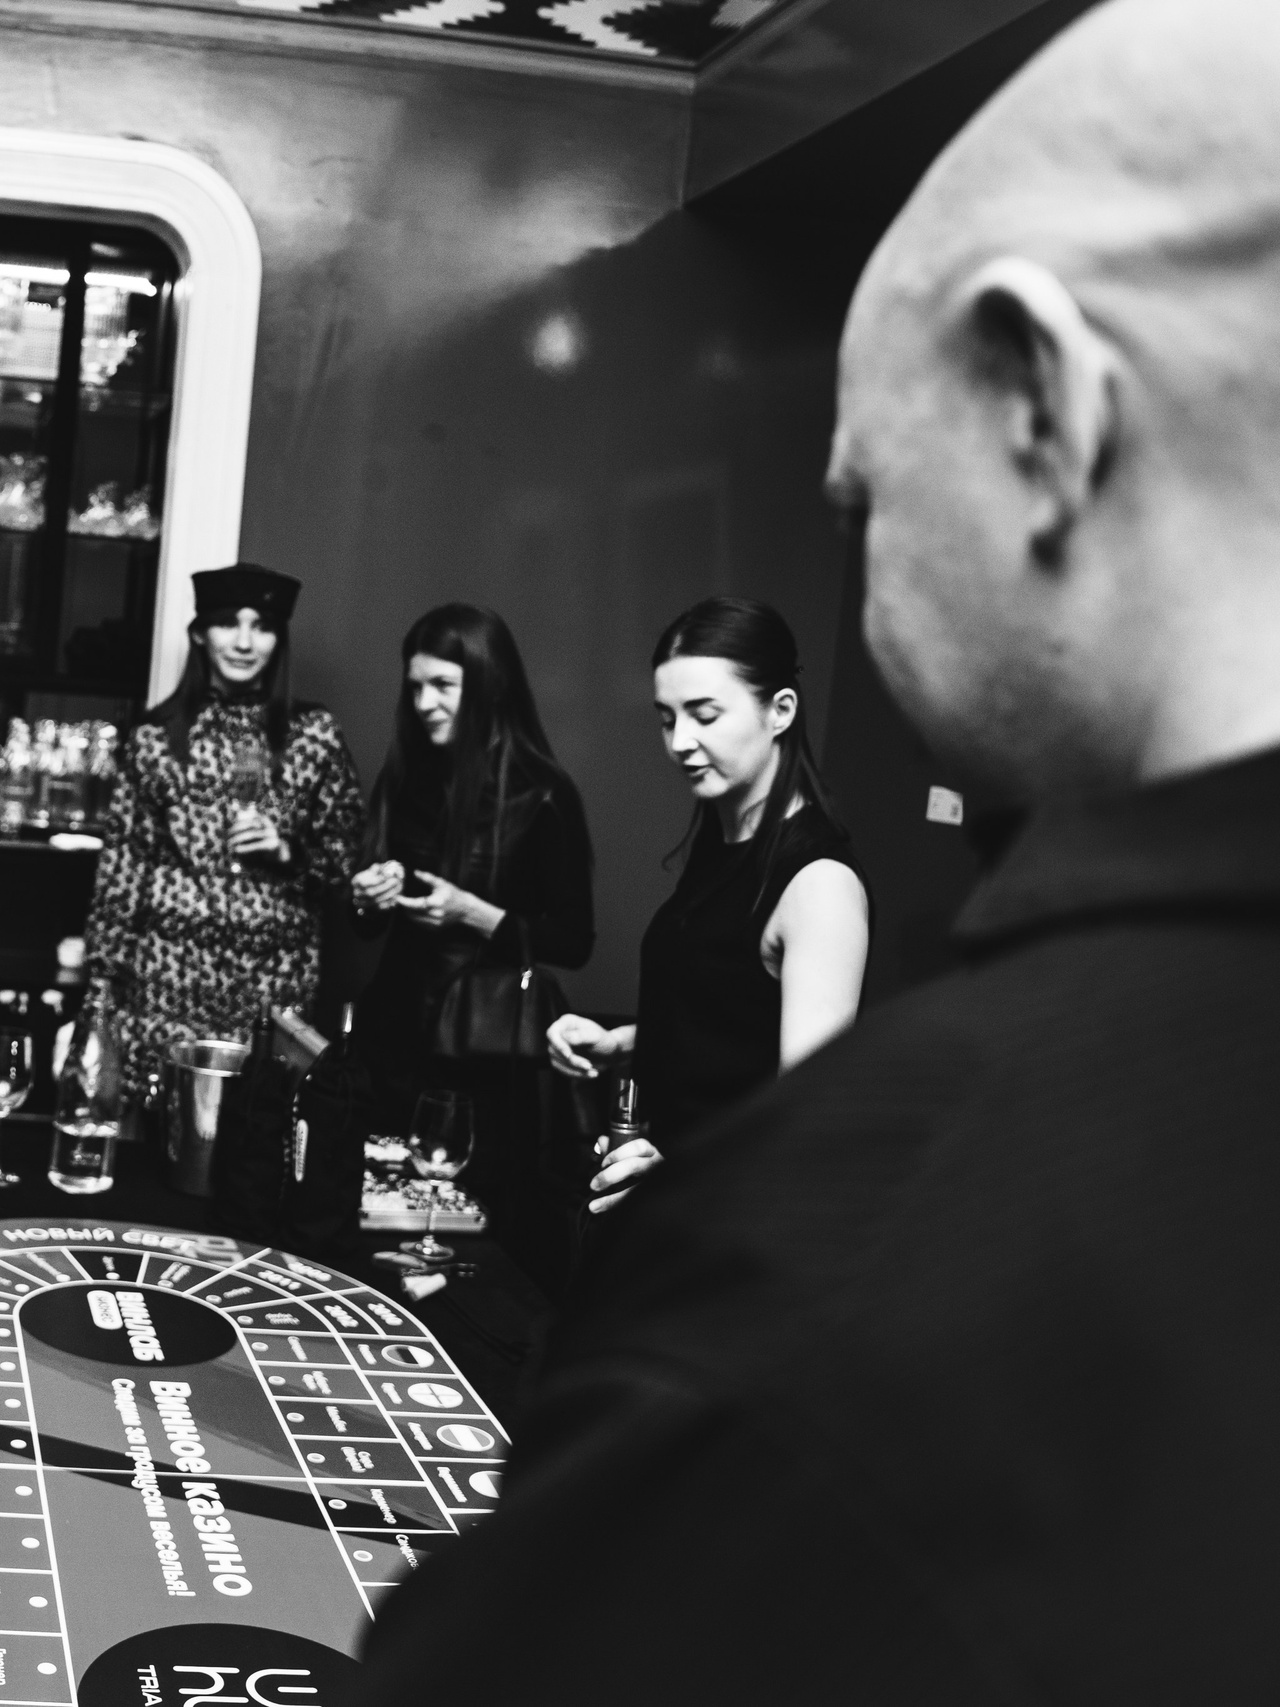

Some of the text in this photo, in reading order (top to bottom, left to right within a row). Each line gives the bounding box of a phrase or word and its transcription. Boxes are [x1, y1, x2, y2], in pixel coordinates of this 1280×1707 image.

[2, 1226, 198, 1257] НОВЫЙ СВЕТ
[111, 1378, 196, 1597] Следим за градусом веселья!
[149, 1380, 253, 1597] Винное казино
[395, 1534, 419, 1571] Санджов
